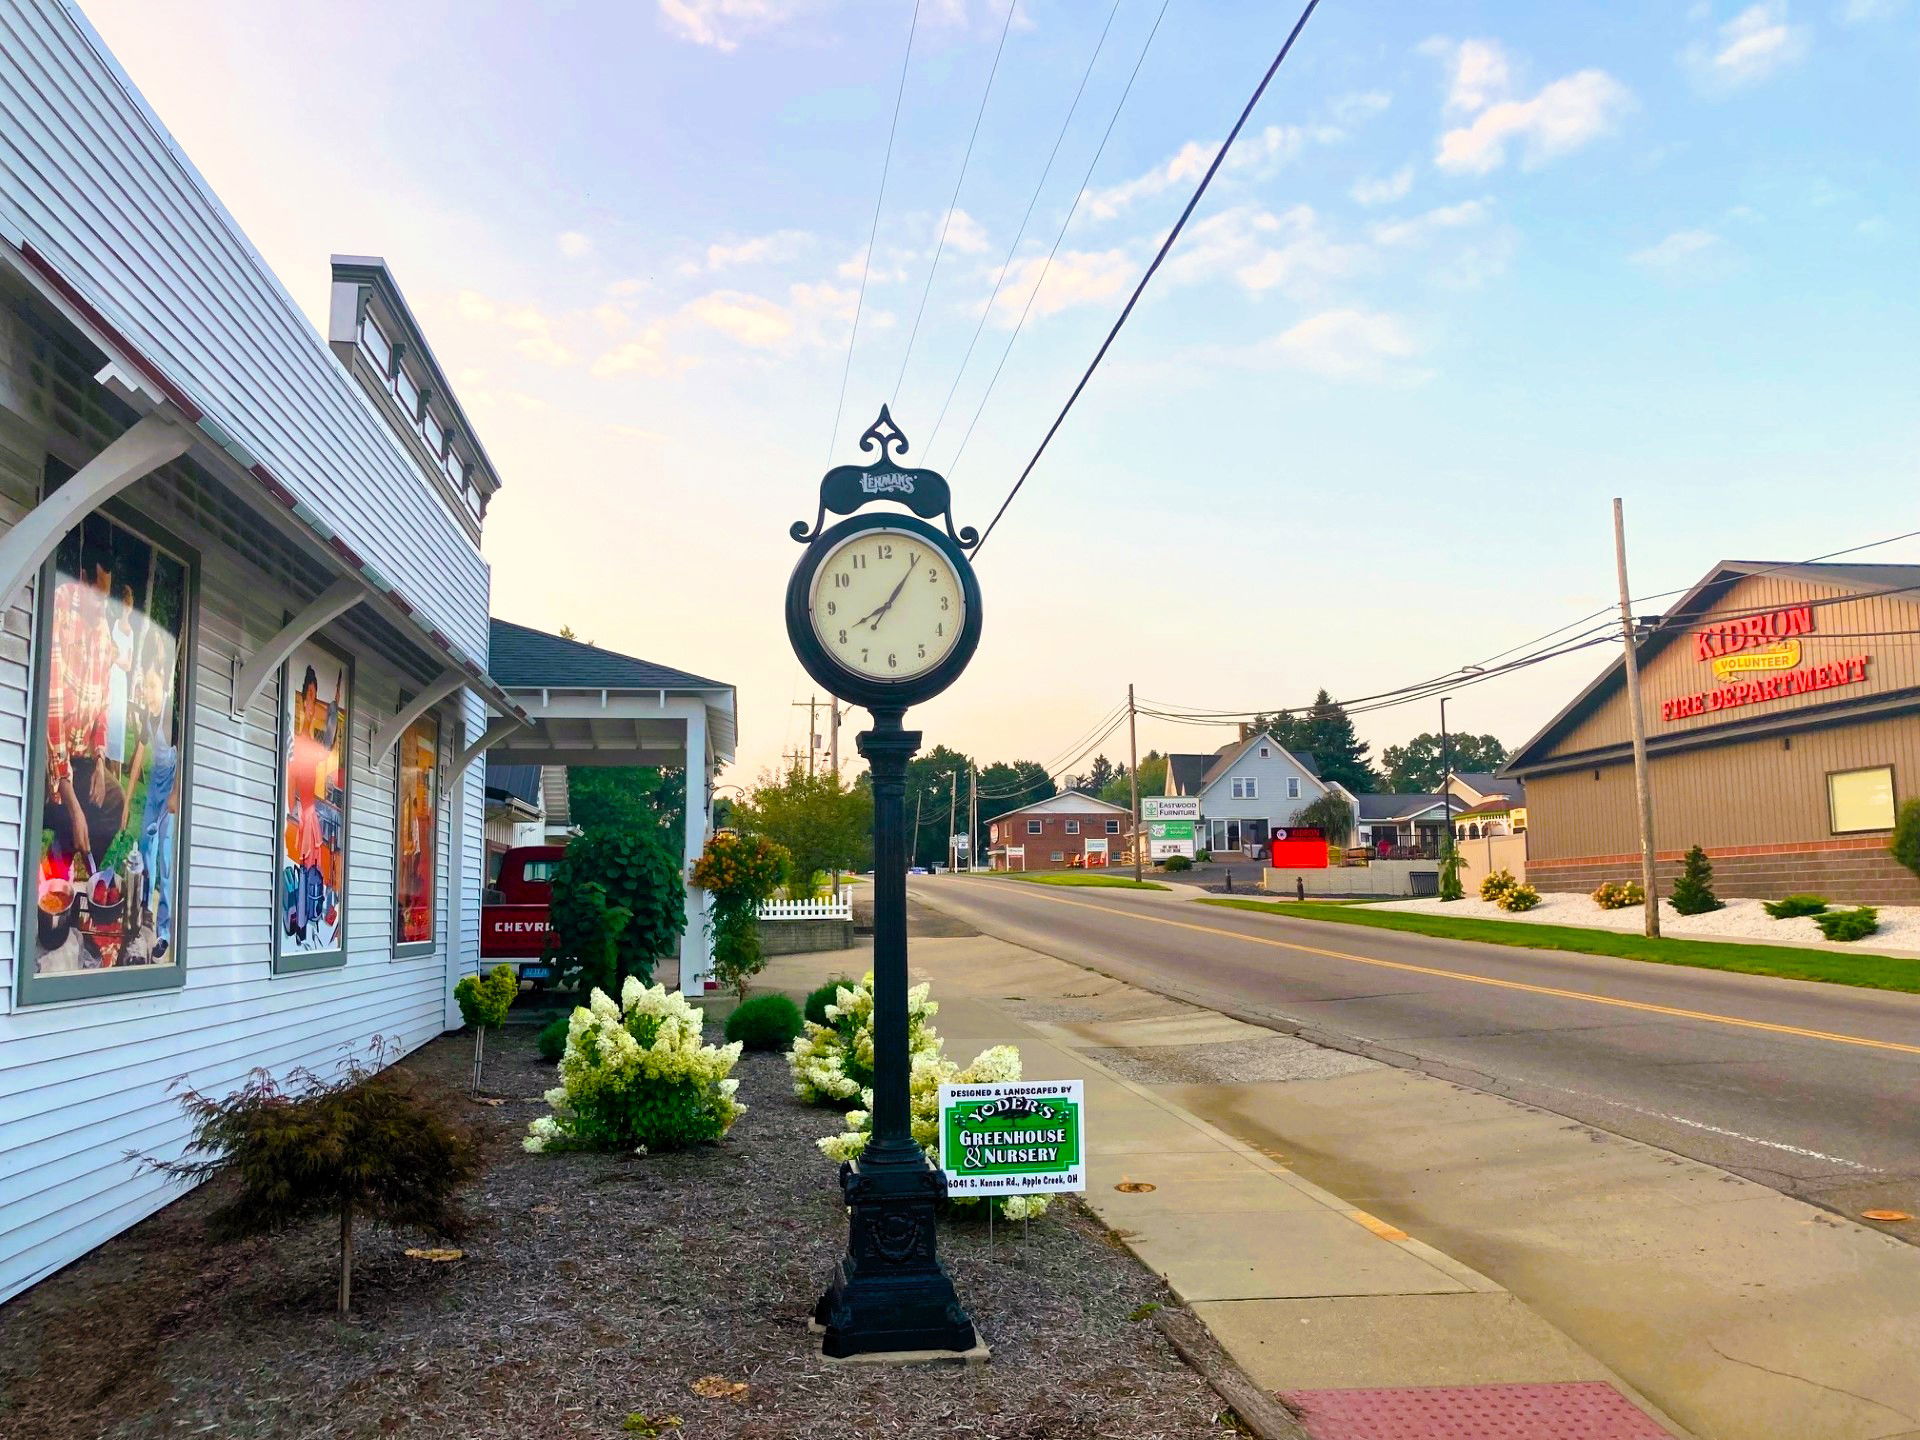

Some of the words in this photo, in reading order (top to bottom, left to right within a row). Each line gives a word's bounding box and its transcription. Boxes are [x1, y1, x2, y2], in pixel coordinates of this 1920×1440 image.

[877, 545, 893, 560] 12
[852, 554, 867, 570] 11
[834, 573, 850, 588] 10
[929, 568, 938, 584] 2
[827, 601, 837, 616] 9
[940, 596, 949, 611] 3
[838, 629, 848, 644] 8
[934, 622, 944, 637] 4
[1692, 601, 1814, 662] KIDRON
[861, 648, 870, 663] 7
[917, 643, 926, 659] 5
[887, 653, 897, 668] 6
[1720, 655, 1790, 670] VOLUNTEER
[1661, 692, 1704, 722] FIRE
[1707, 656, 1868, 713] DEPARTMENT
[950, 1089, 992, 1098] DESIGNED
[995, 1088, 1001, 1096] &
[1004, 1086, 1058, 1096] LANDSCAPED
[968, 1096, 1055, 1123] YODER'S
[959, 1129, 1066, 1146] GREENHOUSE
[963, 1145, 985, 1168] &
[985, 1148, 1058, 1164] NURSERY
[948, 1179, 968, 1188] 6041
[970, 1179, 978, 1188] S.
[980, 1178, 1004, 1187] Kansas
[1022, 1176, 1042, 1188] Apple
[1067, 1174, 1078, 1183] OH
